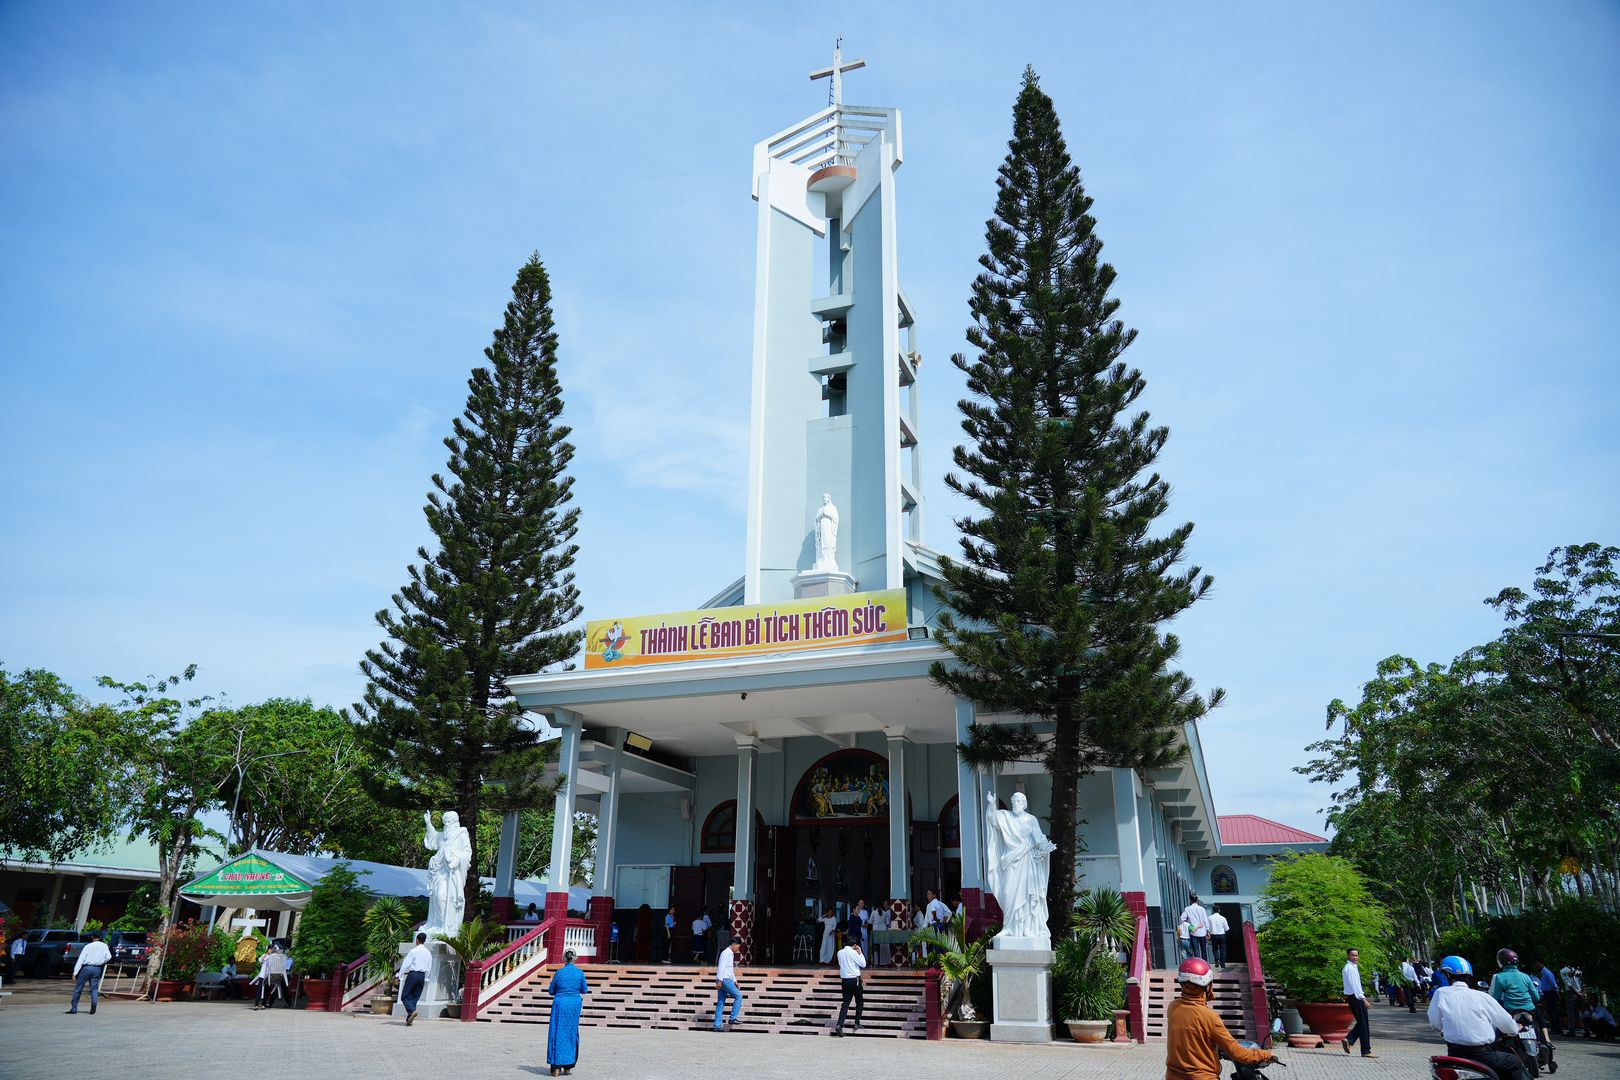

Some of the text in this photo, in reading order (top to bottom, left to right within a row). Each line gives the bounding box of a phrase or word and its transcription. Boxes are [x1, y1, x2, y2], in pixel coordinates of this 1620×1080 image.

[640, 599, 886, 655] THÁNH LỄ BAN BÍ TÍCH THÊM SỨC
